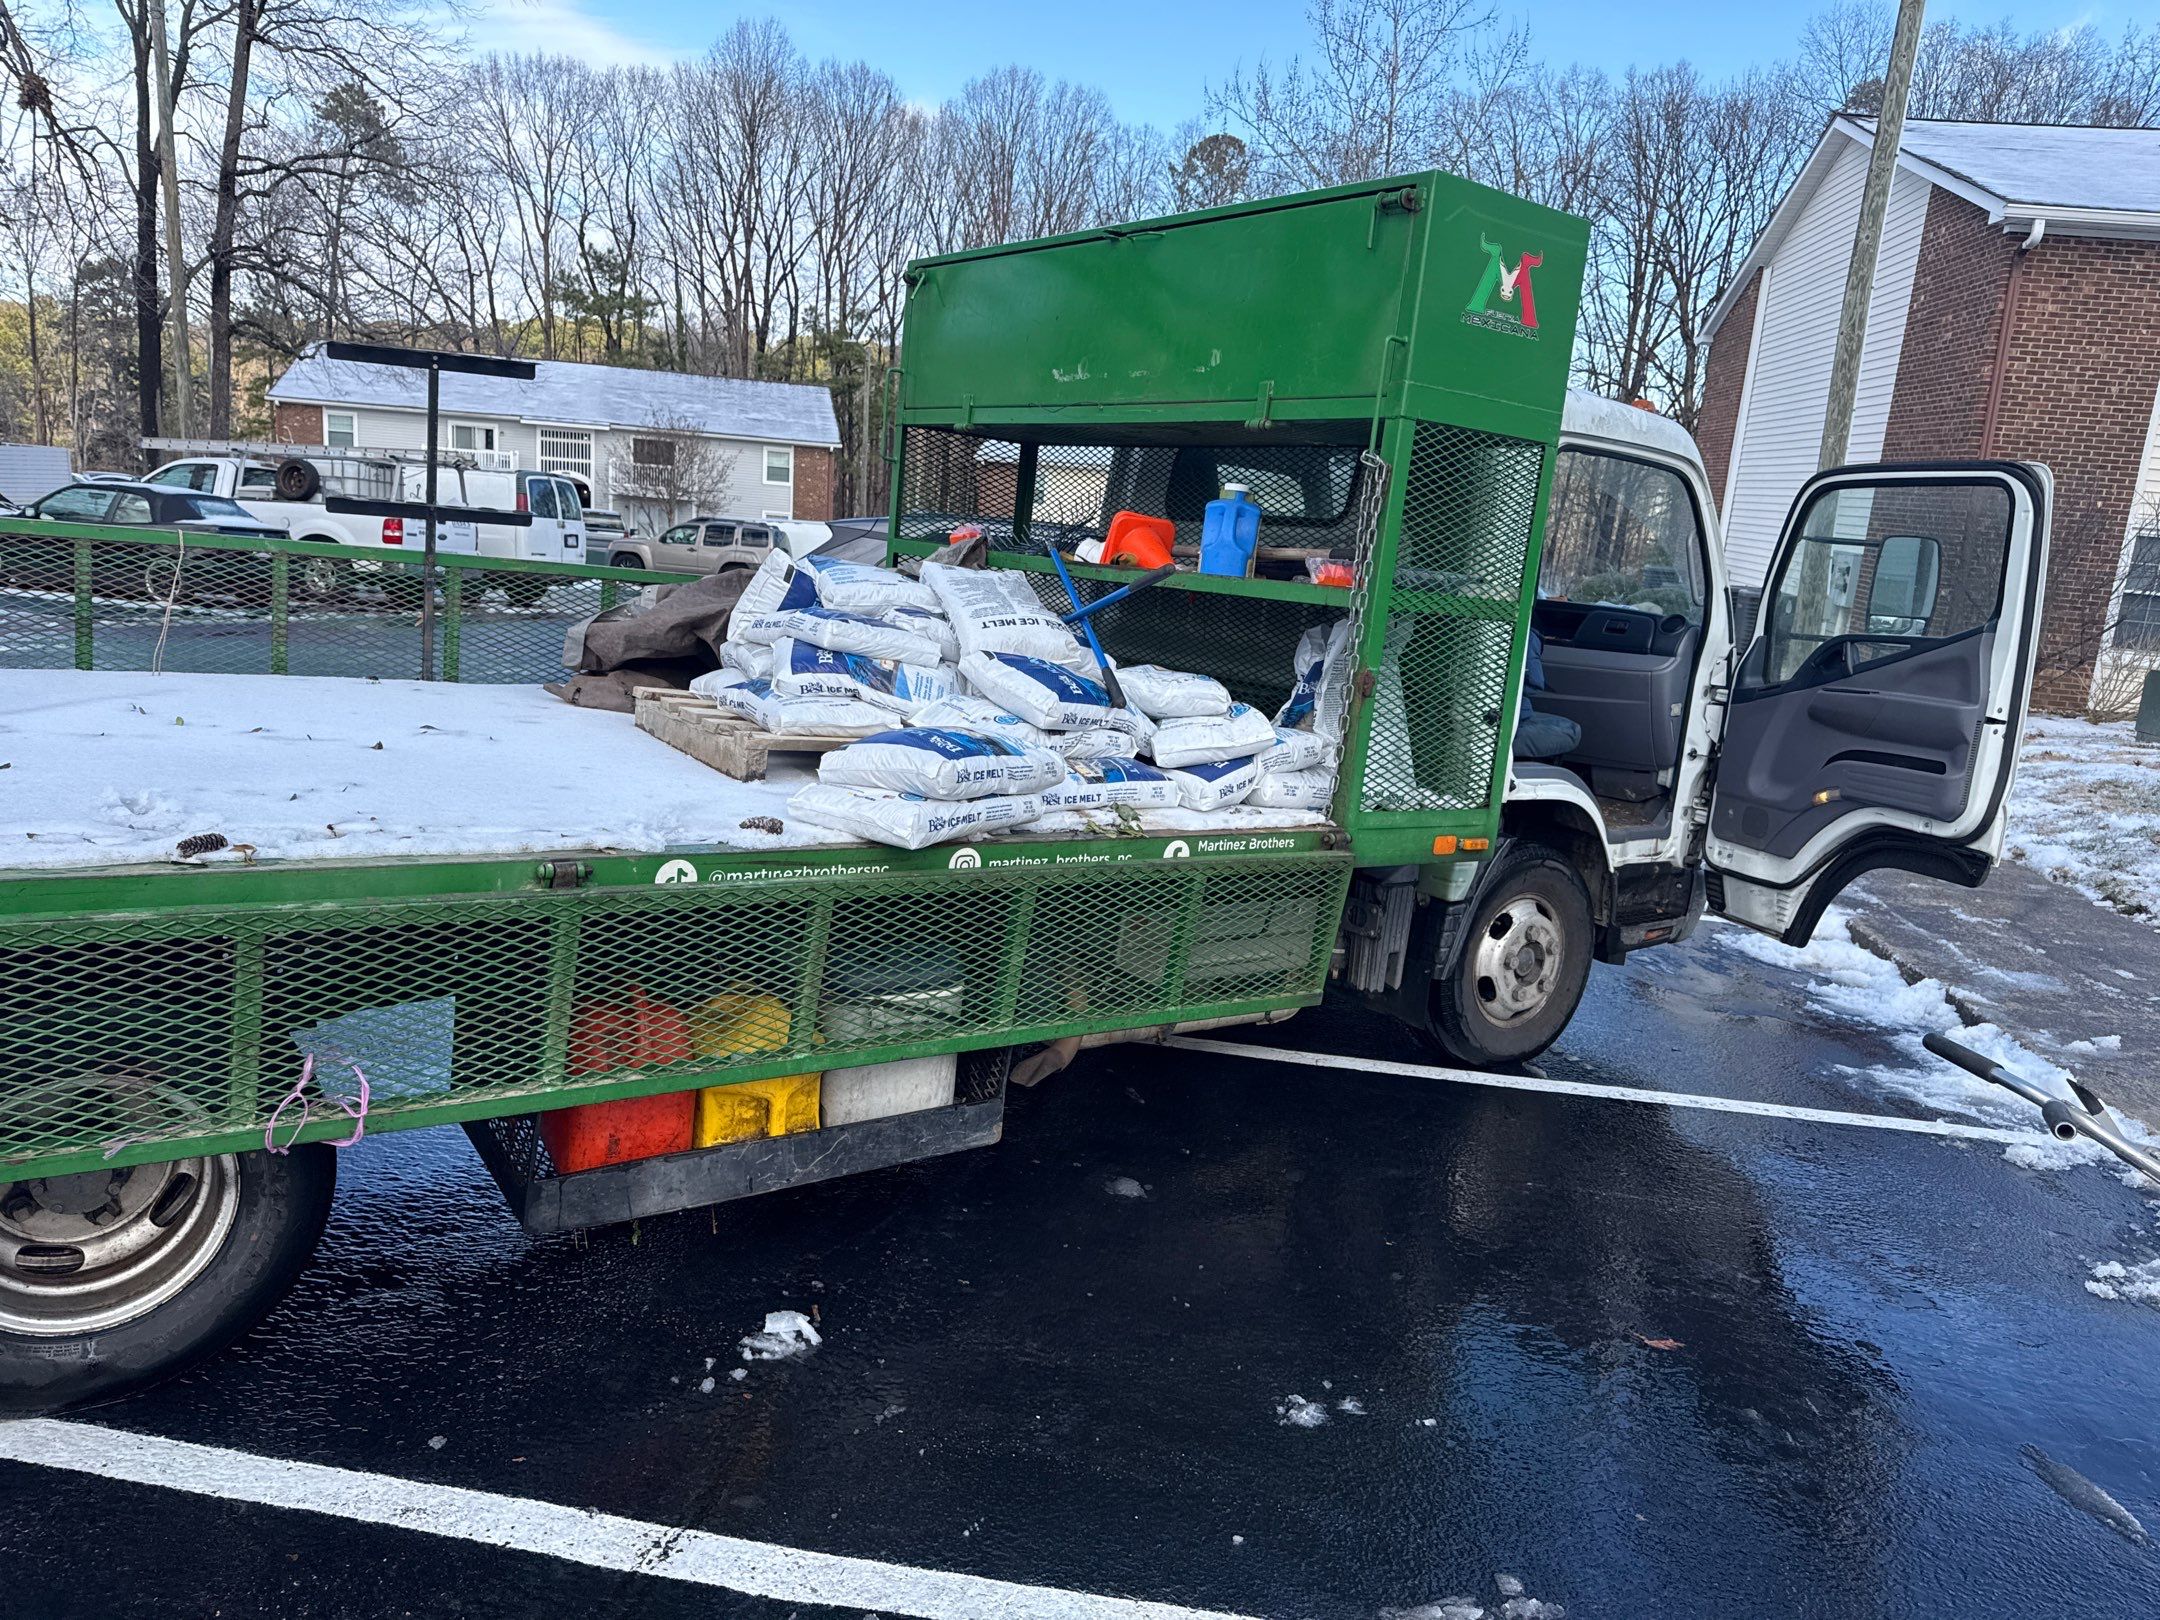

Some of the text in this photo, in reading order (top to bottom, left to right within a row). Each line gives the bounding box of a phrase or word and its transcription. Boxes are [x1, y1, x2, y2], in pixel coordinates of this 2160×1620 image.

[1461, 312, 1539, 341] MEXICANA
[982, 618, 1017, 629] MELT
[1020, 617, 1040, 626] ICE
[800, 684, 825, 695] Best
[973, 770, 985, 781] ICE
[986, 768, 1004, 779] MELT
[1236, 780, 1247, 790] ICE
[1041, 795, 1061, 806] Best
[1064, 795, 1078, 804] ICE
[1080, 793, 1102, 803] MELT
[961, 812, 981, 824] MELT
[1198, 837, 1295, 852] Martinez Brothers
